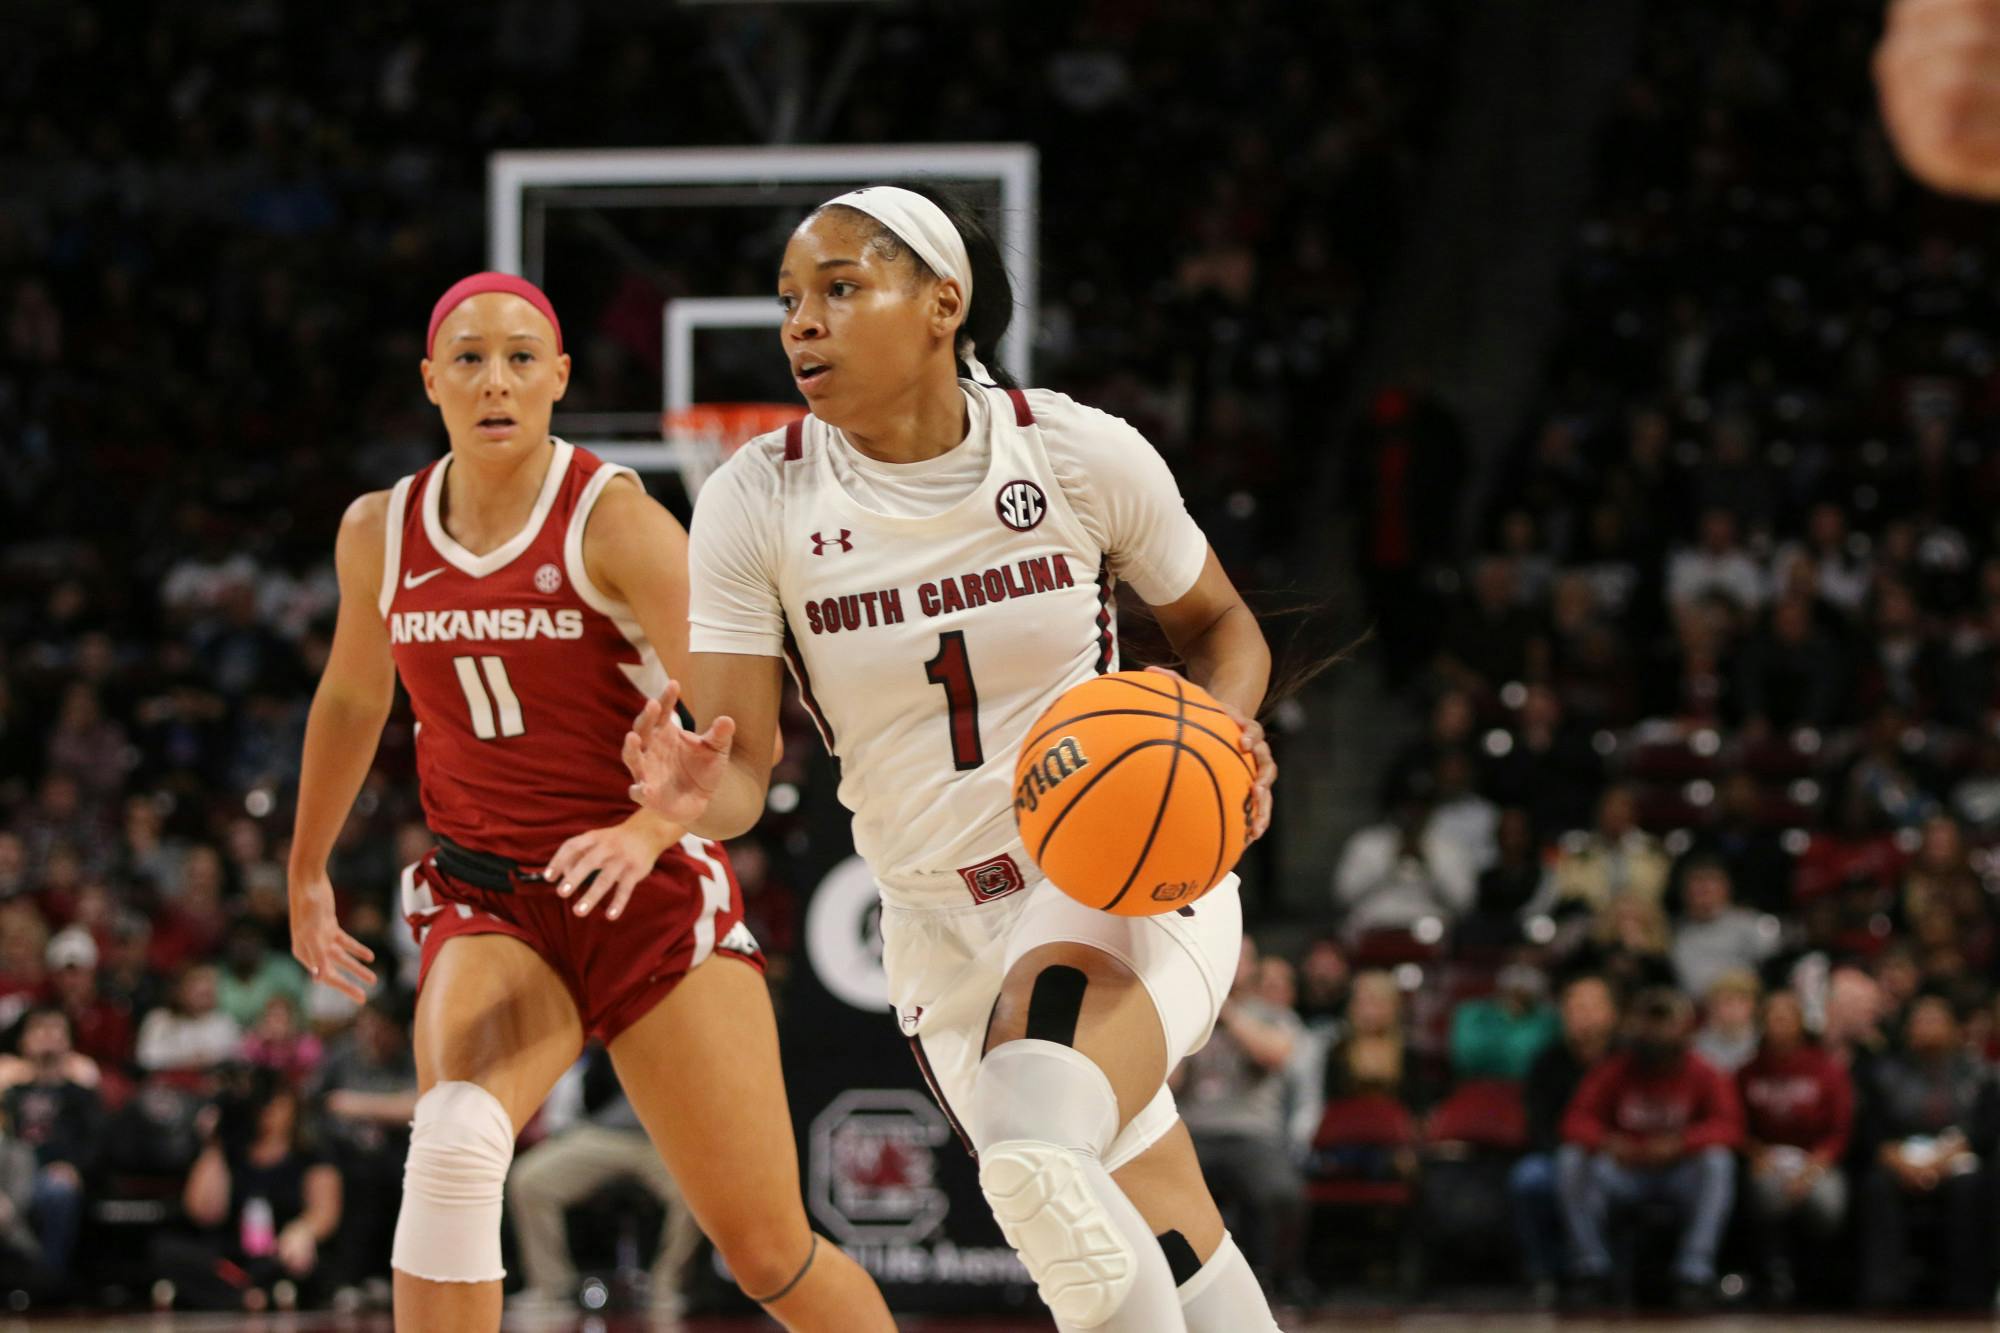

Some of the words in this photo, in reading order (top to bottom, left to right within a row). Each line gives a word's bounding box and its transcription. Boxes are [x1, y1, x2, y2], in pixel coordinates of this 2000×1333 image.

[998, 482, 1044, 529] SEC
[390, 607, 584, 644] ARKANSAS
[804, 588, 905, 635] SOUTH
[917, 553, 1075, 618] CAROLINA
[452, 655, 526, 740] 11
[924, 629, 985, 772] 1
